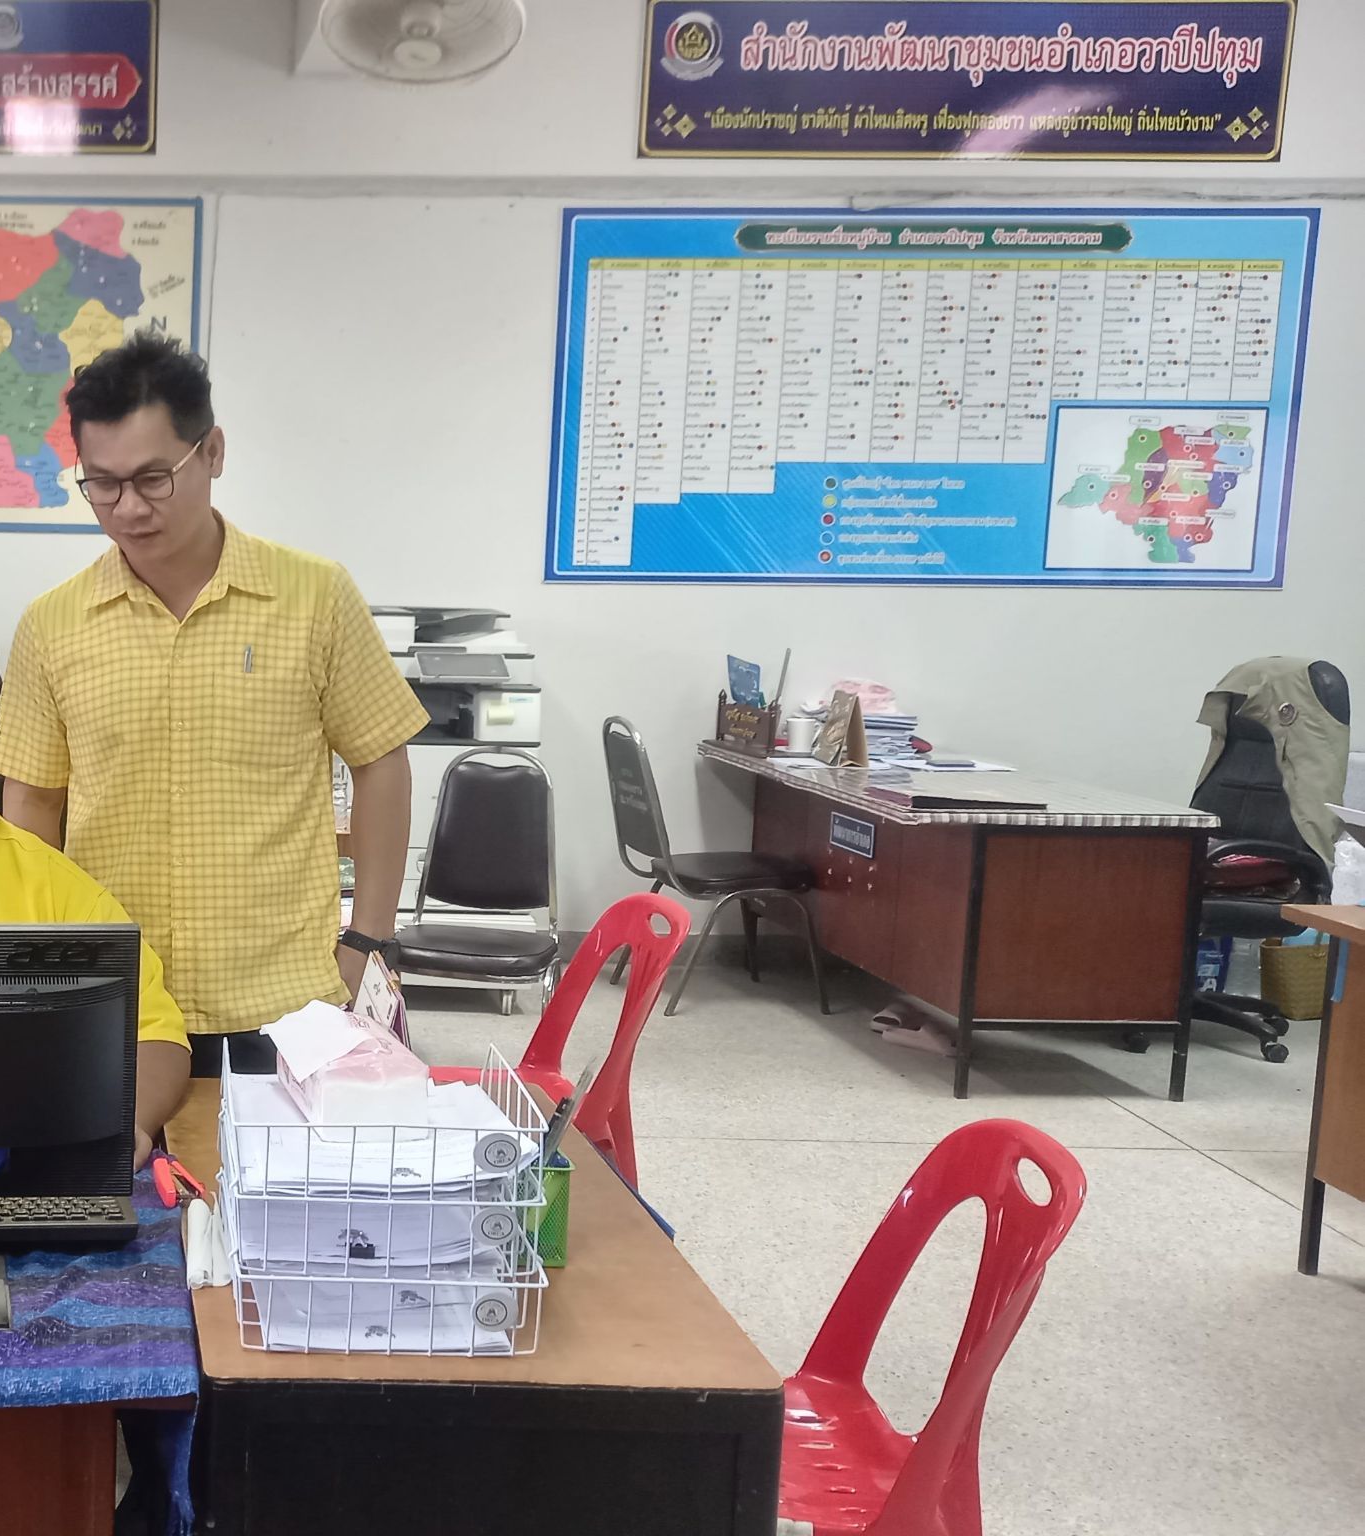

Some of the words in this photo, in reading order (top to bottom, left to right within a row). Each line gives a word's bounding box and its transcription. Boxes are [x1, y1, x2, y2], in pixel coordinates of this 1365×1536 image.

[740, 21, 1262, 88] สำนักงานพัฒนาชุมชนอำเภอวาปีปทุม
[150, 316, 167, 332] N
[6, 940, 116, 969] acer
